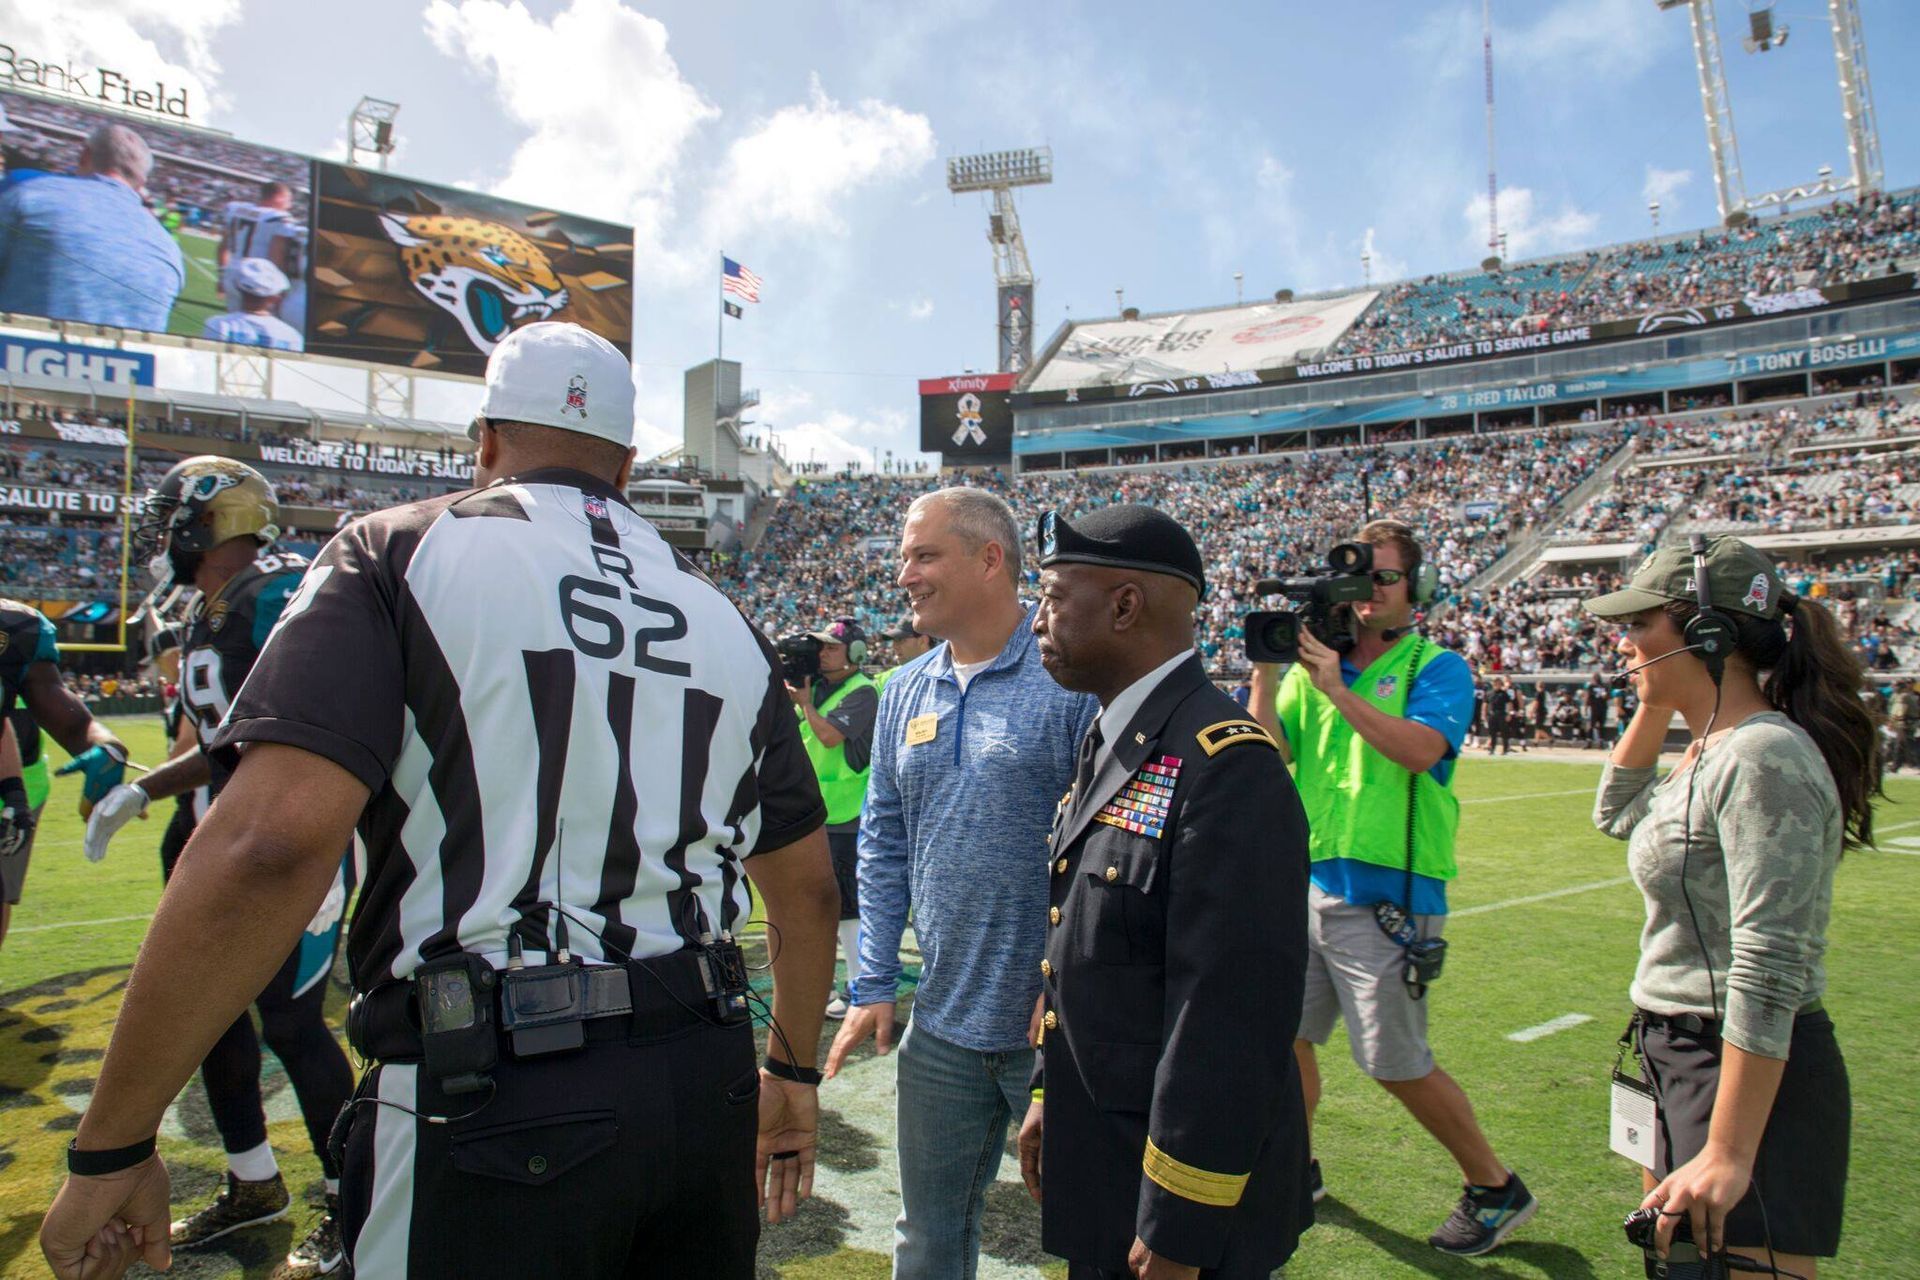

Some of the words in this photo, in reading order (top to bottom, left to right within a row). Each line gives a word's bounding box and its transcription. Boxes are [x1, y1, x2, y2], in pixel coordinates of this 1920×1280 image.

[98, 68, 189, 118] Field
[1714, 306, 1735, 319] VS
[6, 344, 140, 385] IGHT
[1296, 360, 1354, 378] WELCOME
[1357, 357, 1372, 370] TO
[1374, 350, 1424, 368] TODAY'S
[1425, 344, 1473, 362] SALUTE
[1476, 340, 1493, 355] TO
[1494, 332, 1550, 353] SERVICE
[1551, 327, 1592, 344] GAME
[1727, 358, 1747, 375] 71
[1757, 352, 1802, 371] TONY
[1810, 339, 1887, 363] BOSELLI
[948, 376, 989, 392] xfinity
[1184, 378, 1200, 390] VS
[1441, 395, 1458, 410] 28
[1466, 390, 1501, 407] FRED
[1504, 383, 1558, 403] TAYLOR
[0, 420, 21, 434] VS
[260, 445, 340, 469] WELCOME
[344, 455, 364, 472] TO
[368, 457, 429, 477] TODAY'S
[0, 487, 82, 511] SALUTE
[86, 493, 115, 513] TO
[590, 545, 640, 590] R
[559, 574, 691, 677] 62
